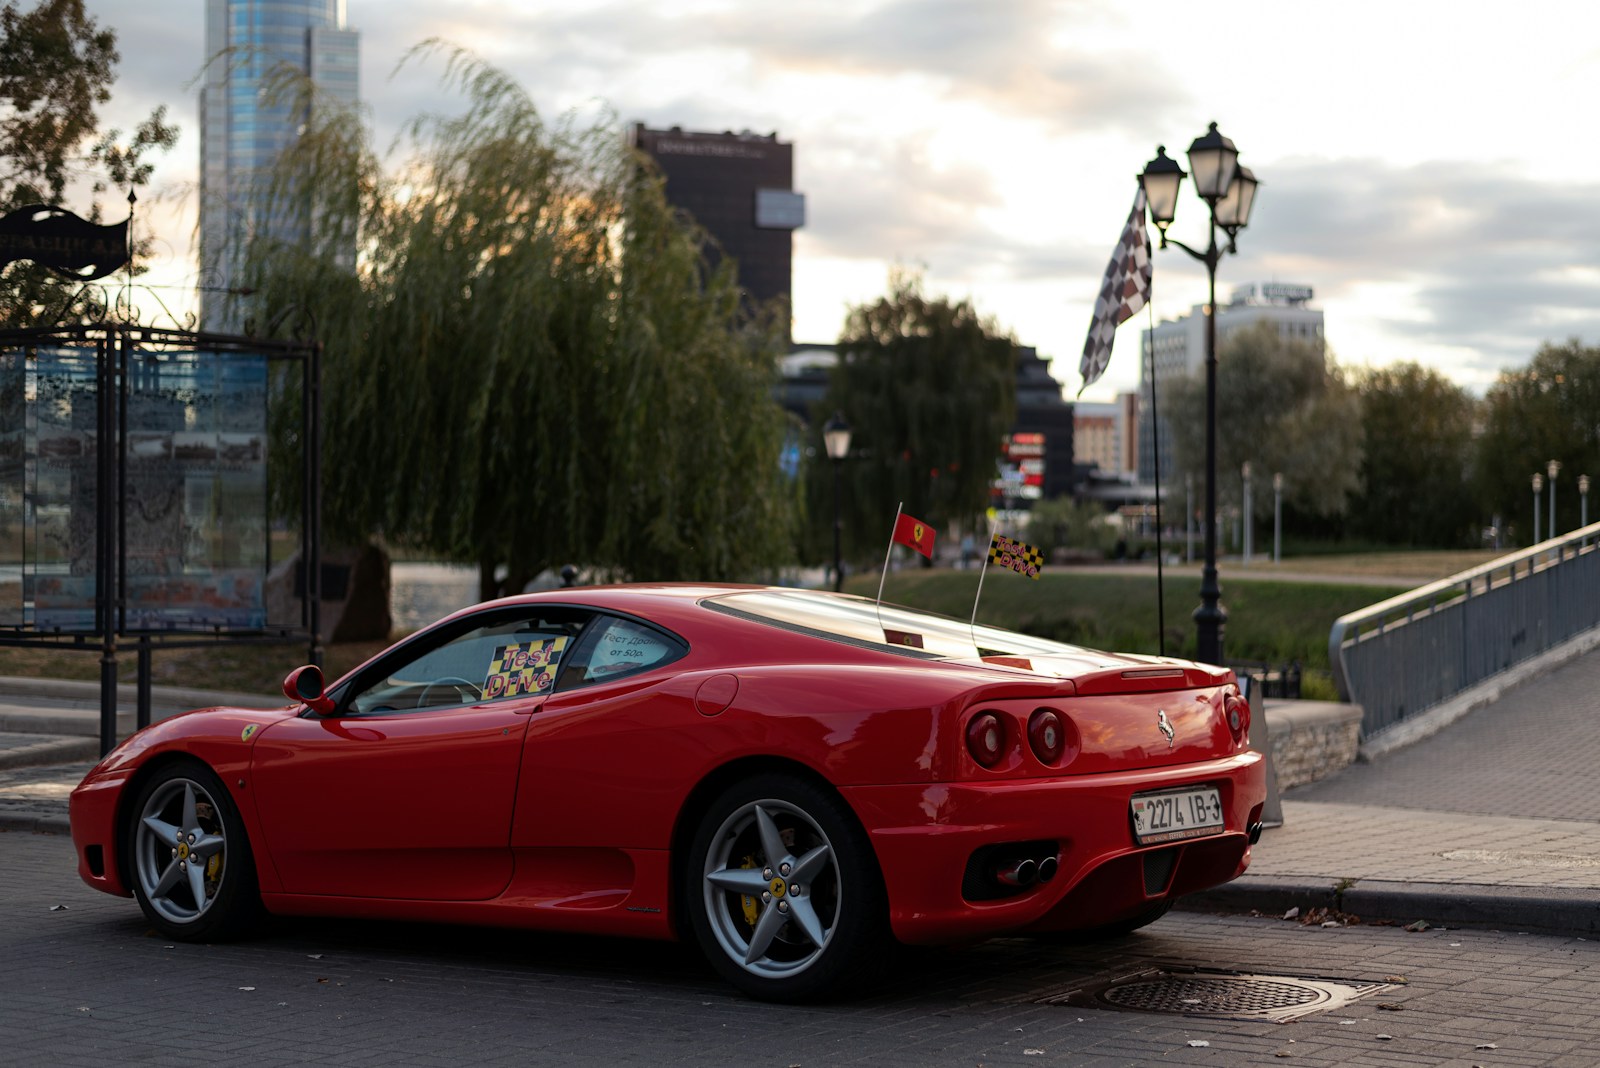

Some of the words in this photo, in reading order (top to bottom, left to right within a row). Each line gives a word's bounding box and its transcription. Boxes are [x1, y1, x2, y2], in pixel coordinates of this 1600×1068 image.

[997, 536, 1026, 557] Test
[1000, 553, 1037, 576] Drive
[604, 632, 628, 643] Тест
[504, 642, 554, 670] Test
[623, 649, 644, 658] 50р.
[487, 671, 551, 697] Drive
[1147, 797, 1184, 829] 2274
[1188, 793, 1220, 824] IB-3
[1136, 819, 1145, 831] BY
